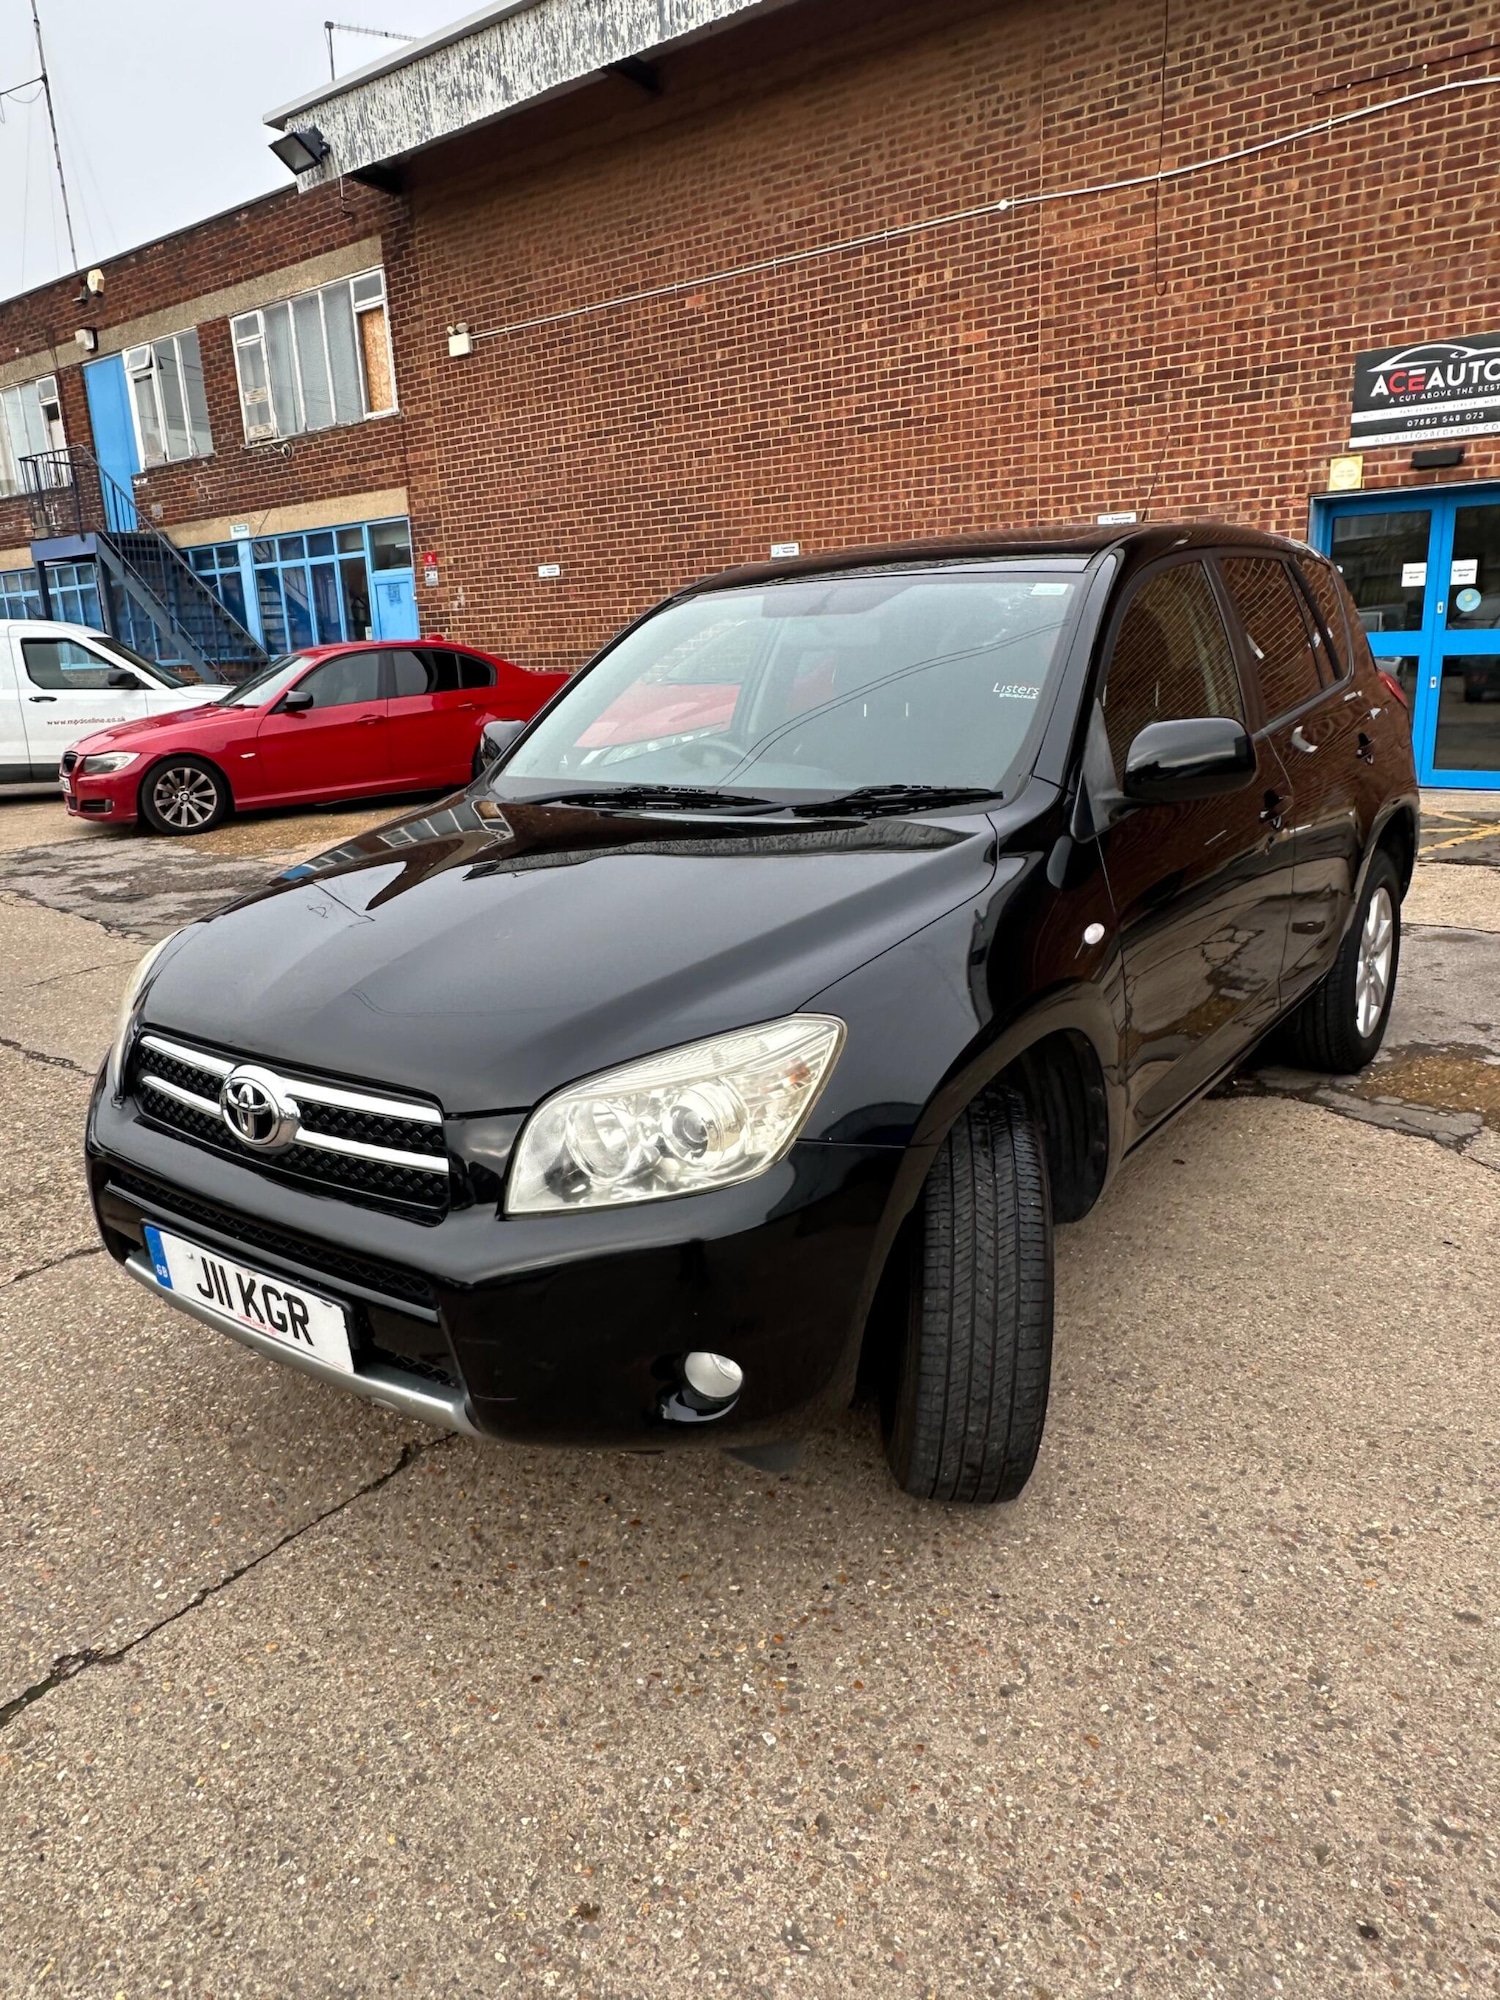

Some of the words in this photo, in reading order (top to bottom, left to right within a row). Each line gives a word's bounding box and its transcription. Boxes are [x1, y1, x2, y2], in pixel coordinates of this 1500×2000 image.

[1399, 394, 1417, 402] CUT
[1420, 388, 1451, 400] ABOVE
[1456, 386, 1474, 395] THE
[1478, 384, 1500, 393] REST
[1465, 412, 1485, 420] 073
[992, 682, 1040, 696] Listers
[156, 1263, 168, 1278] GB
[197, 1257, 234, 1310] J11
[235, 1272, 315, 1346] KGR
